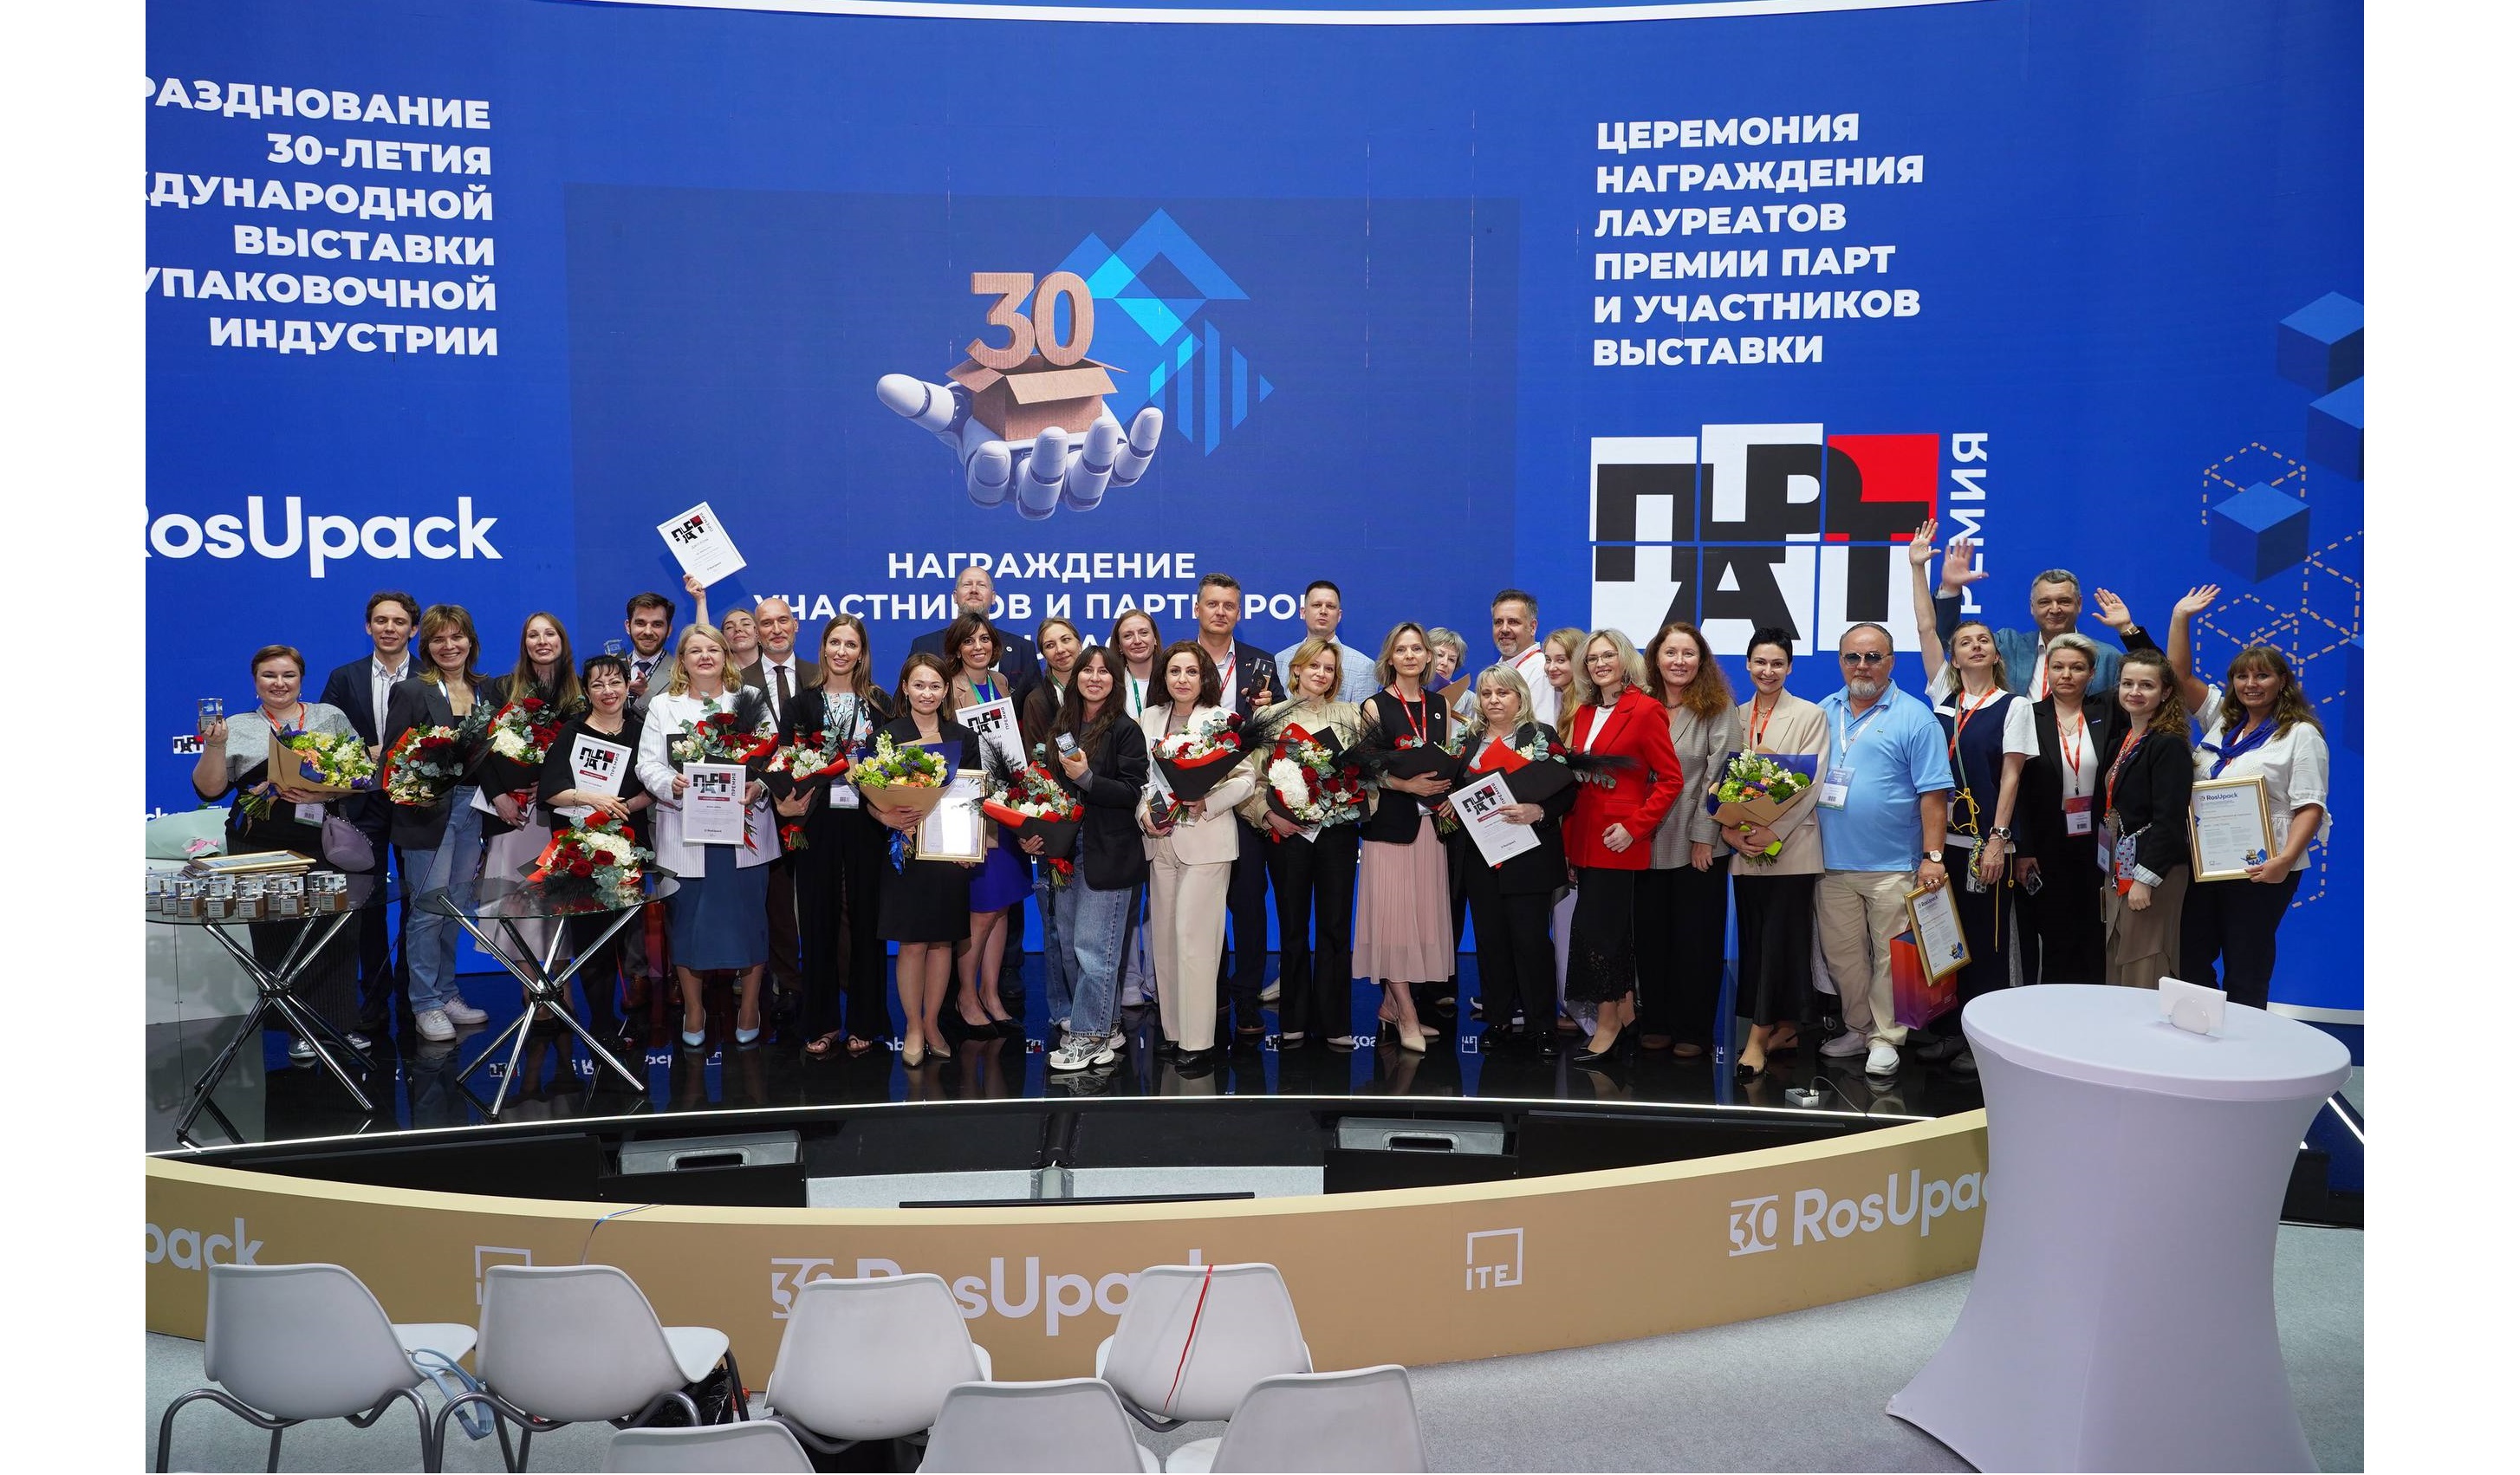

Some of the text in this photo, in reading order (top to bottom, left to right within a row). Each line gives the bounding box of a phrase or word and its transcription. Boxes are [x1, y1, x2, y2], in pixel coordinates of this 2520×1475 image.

[1598, 113, 1860, 154] ЦЕРЕМОНИЯ
[267, 133, 491, 175] 30-ЛЕТИЯ
[1597, 155, 1924, 193] НАГРАЖДЕНИЯ
[146, 171, 493, 221] ДУНАРОДНОЙ
[1594, 204, 1847, 237] ЛАУРЕАТОВ
[234, 224, 495, 266] ВЫСТАВКИ
[1595, 245, 1895, 280] ПРЕМИИ ПАРТ
[964, 271, 1094, 369] 30
[1594, 289, 1920, 323] И УЧАСТНИКОВ
[210, 317, 498, 355] ИНДУСТРИИ
[1594, 336, 1822, 366] ВЫСТАВКИ
[146, 496, 503, 578] osUpack
[889, 553, 1195, 582] НАГРАЖДЕНИЕ
[1046, 594, 1070, 620] И
[2206, 792, 2237, 801] RosUpack
[1729, 1194, 1779, 1257] 30
